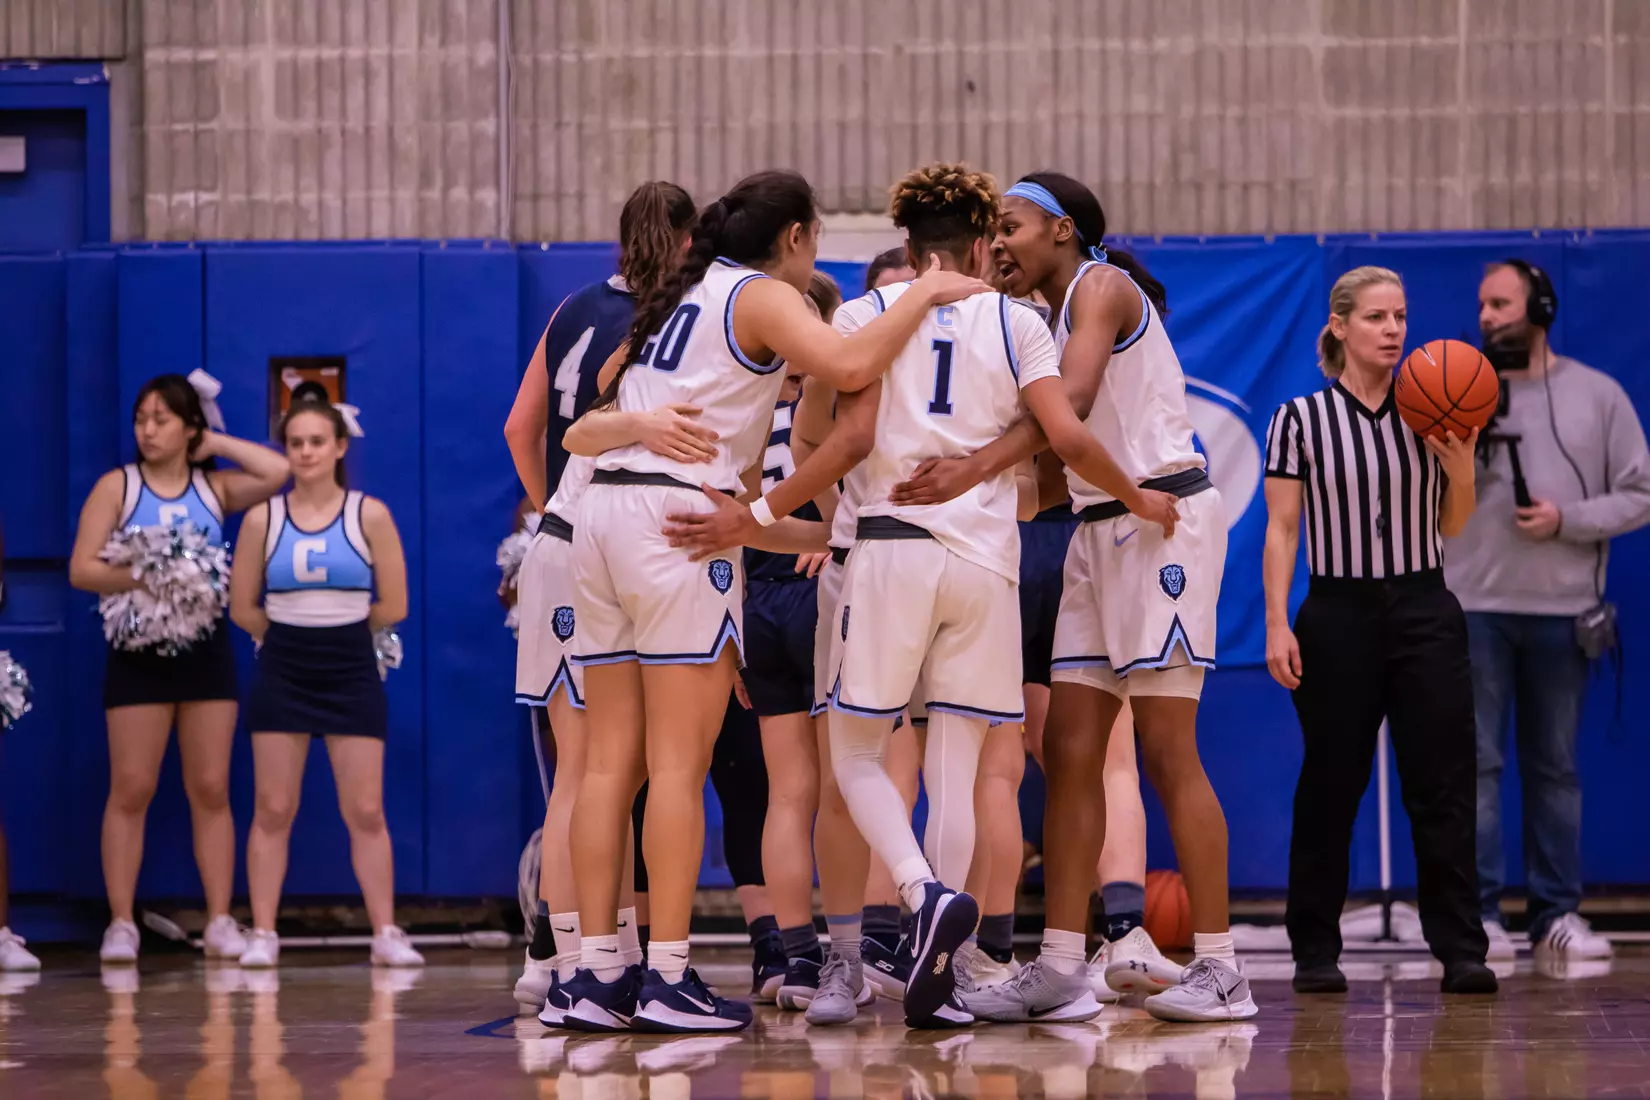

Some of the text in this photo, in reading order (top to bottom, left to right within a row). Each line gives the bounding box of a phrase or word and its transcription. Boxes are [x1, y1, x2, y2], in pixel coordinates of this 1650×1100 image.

[937, 306, 953, 326] C
[554, 326, 595, 419] 4
[928, 338, 954, 416] 1
[293, 539, 327, 582] C
